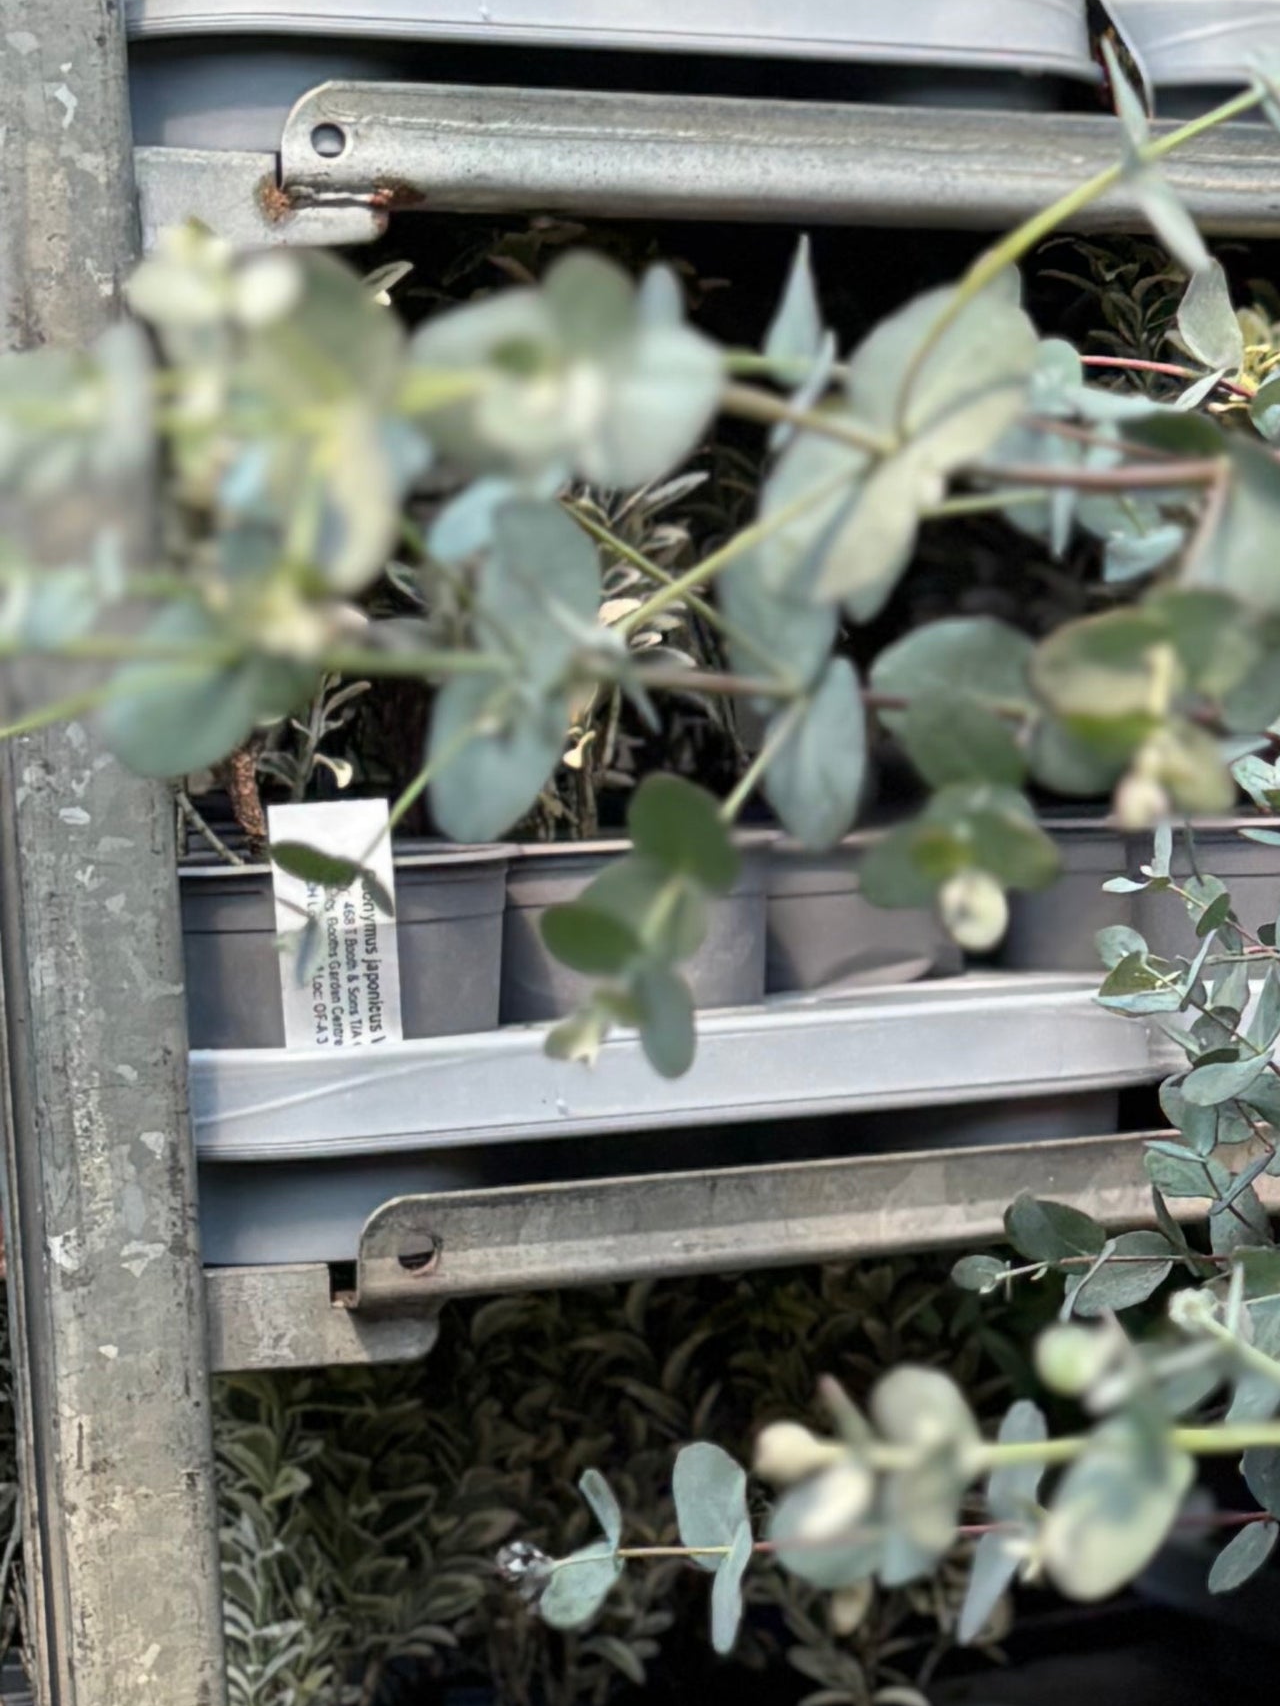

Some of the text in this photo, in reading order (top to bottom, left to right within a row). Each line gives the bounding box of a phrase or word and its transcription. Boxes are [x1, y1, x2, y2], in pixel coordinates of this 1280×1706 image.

[326, 916, 339, 959] Booths
[344, 937, 358, 971] Booth
[328, 959, 342, 1004] Garden
[347, 986, 361, 1017] Sons
[361, 958, 384, 1033] japonicus
[331, 1004, 345, 1046] Centre
